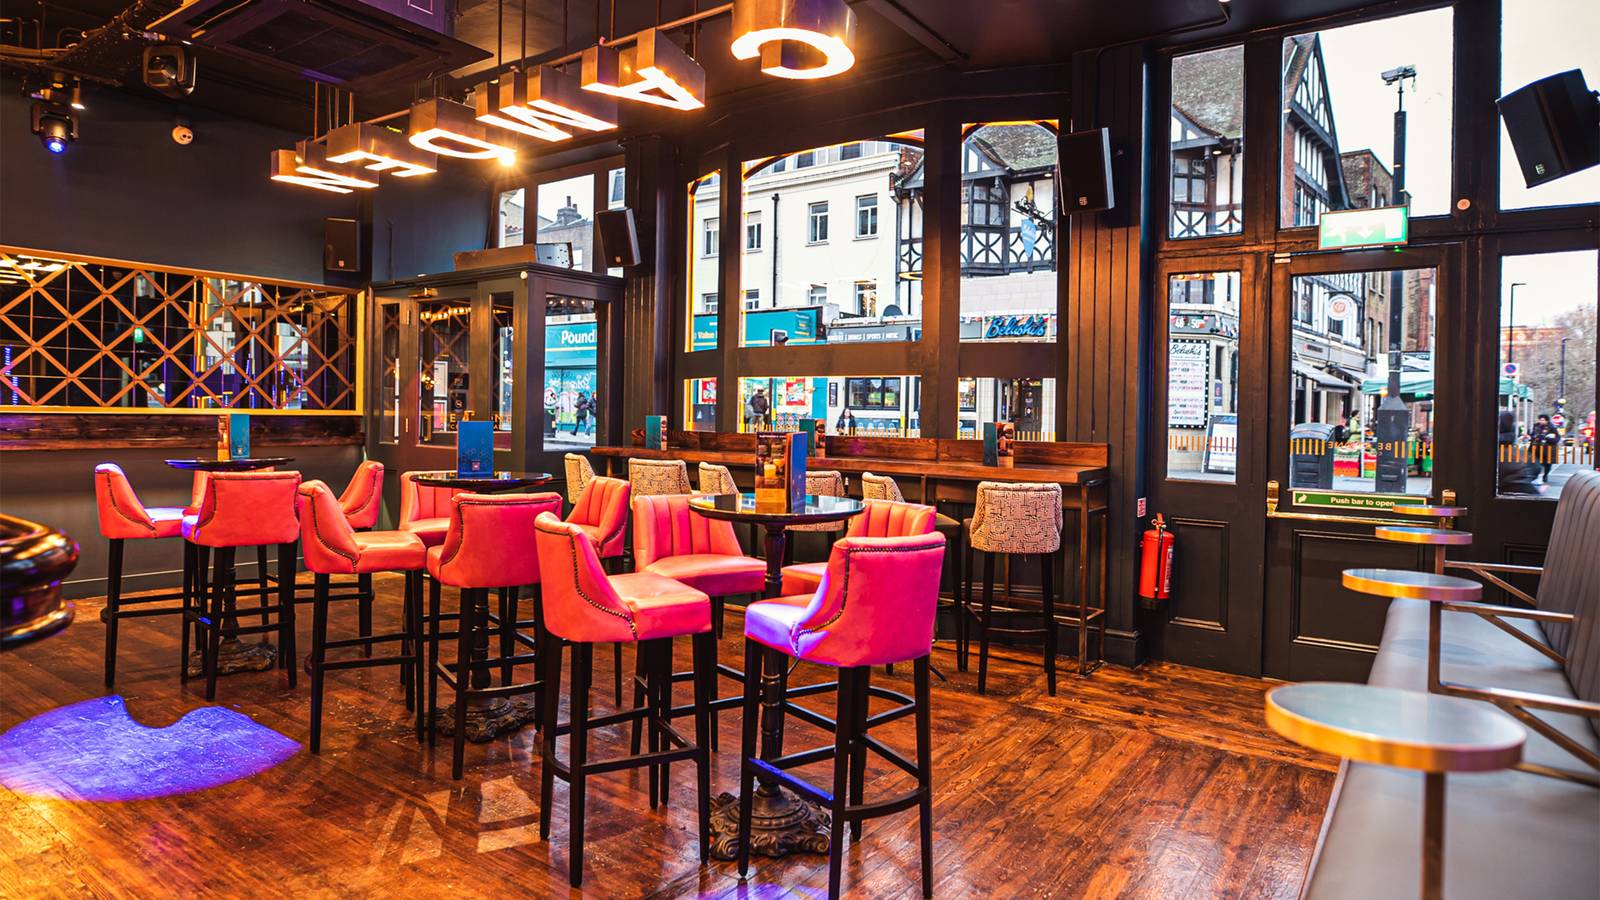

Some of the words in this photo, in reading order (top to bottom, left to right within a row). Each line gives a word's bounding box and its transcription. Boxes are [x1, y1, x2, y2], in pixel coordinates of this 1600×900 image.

[270, 25, 857, 195] CAMDEN
[561, 329, 595, 344] Pound
[1330, 496, 1350, 504] Push
